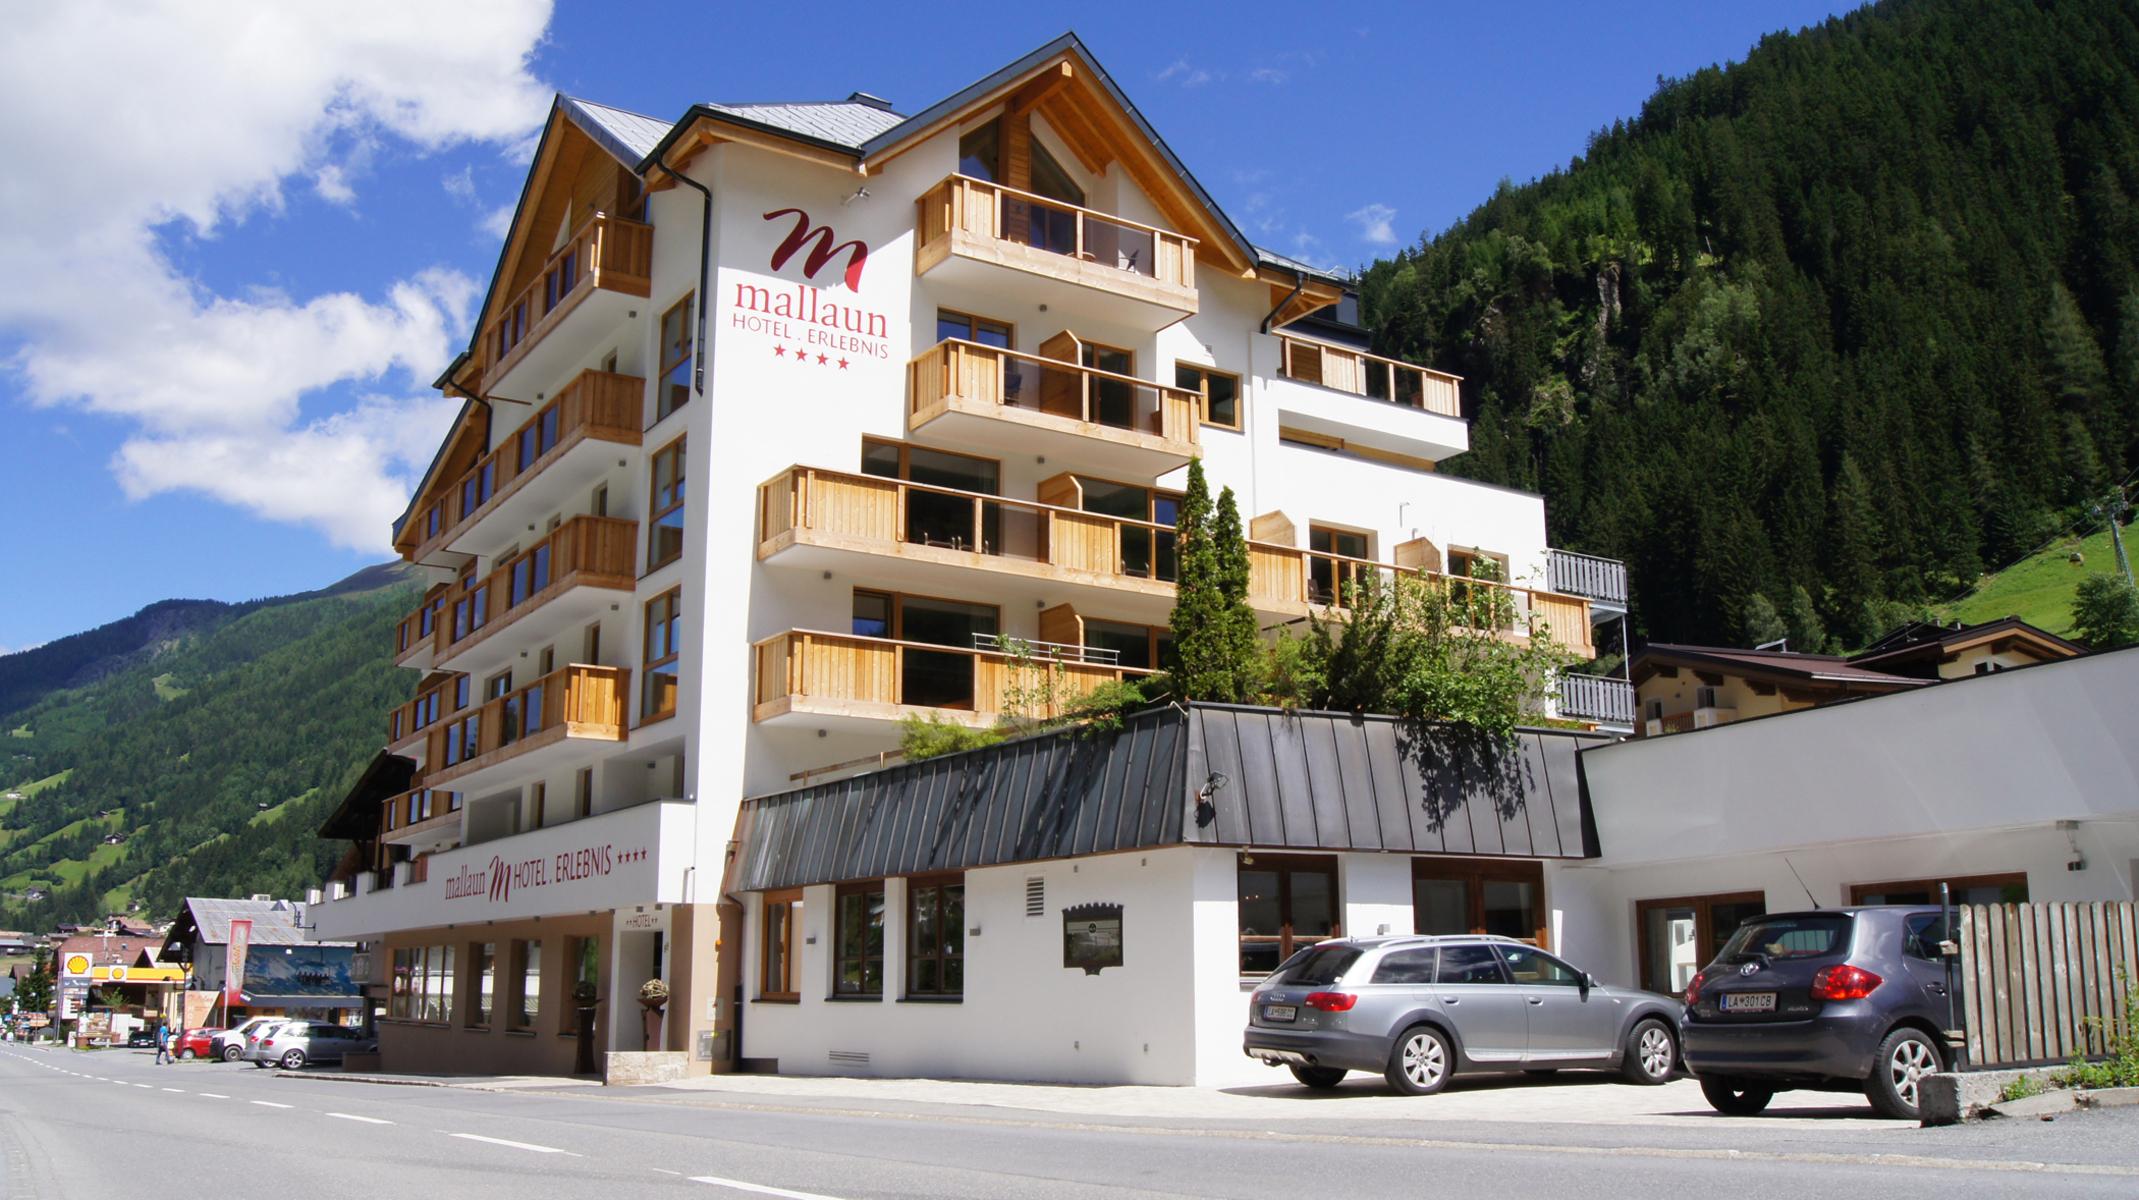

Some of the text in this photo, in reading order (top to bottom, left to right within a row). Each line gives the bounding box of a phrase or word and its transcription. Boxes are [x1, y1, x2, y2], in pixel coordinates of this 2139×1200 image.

[732, 313, 889, 360] HOTEL ERLEBNIS
[734, 283, 889, 338] mallaun
[445, 864, 486, 900] mallaun
[513, 858, 547, 890] HOTEL
[556, 844, 612, 883] ERLEBNIS
